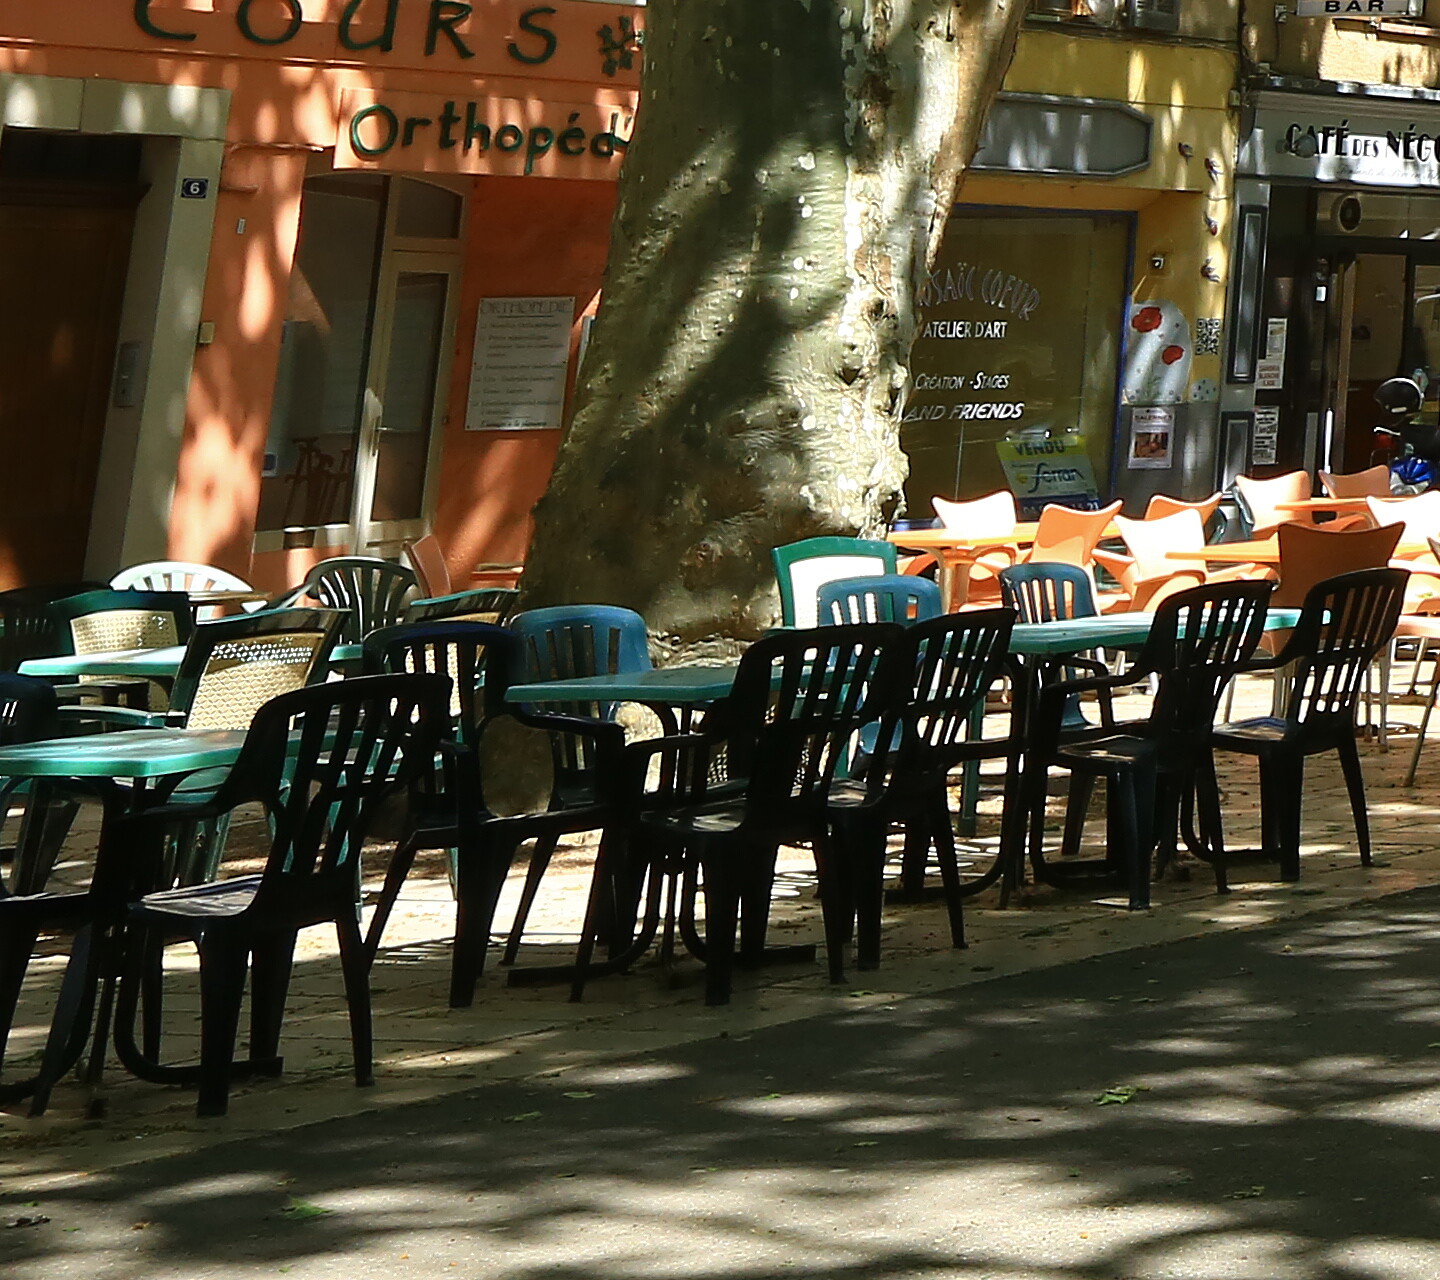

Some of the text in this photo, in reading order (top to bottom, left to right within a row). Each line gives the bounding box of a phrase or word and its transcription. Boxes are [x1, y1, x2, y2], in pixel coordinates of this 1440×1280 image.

[1325, 0, 1384, 12] BAR
[1286, 119, 1350, 157] CAFÉ
[1352, 139, 1379, 157] DES
[188, 182, 201, 195] 6
[922, 321, 1008, 338] ATELIER D'ART
[903, 402, 1025, 423] AND FRIENDS
[1013, 439, 1066, 456] VENDU
